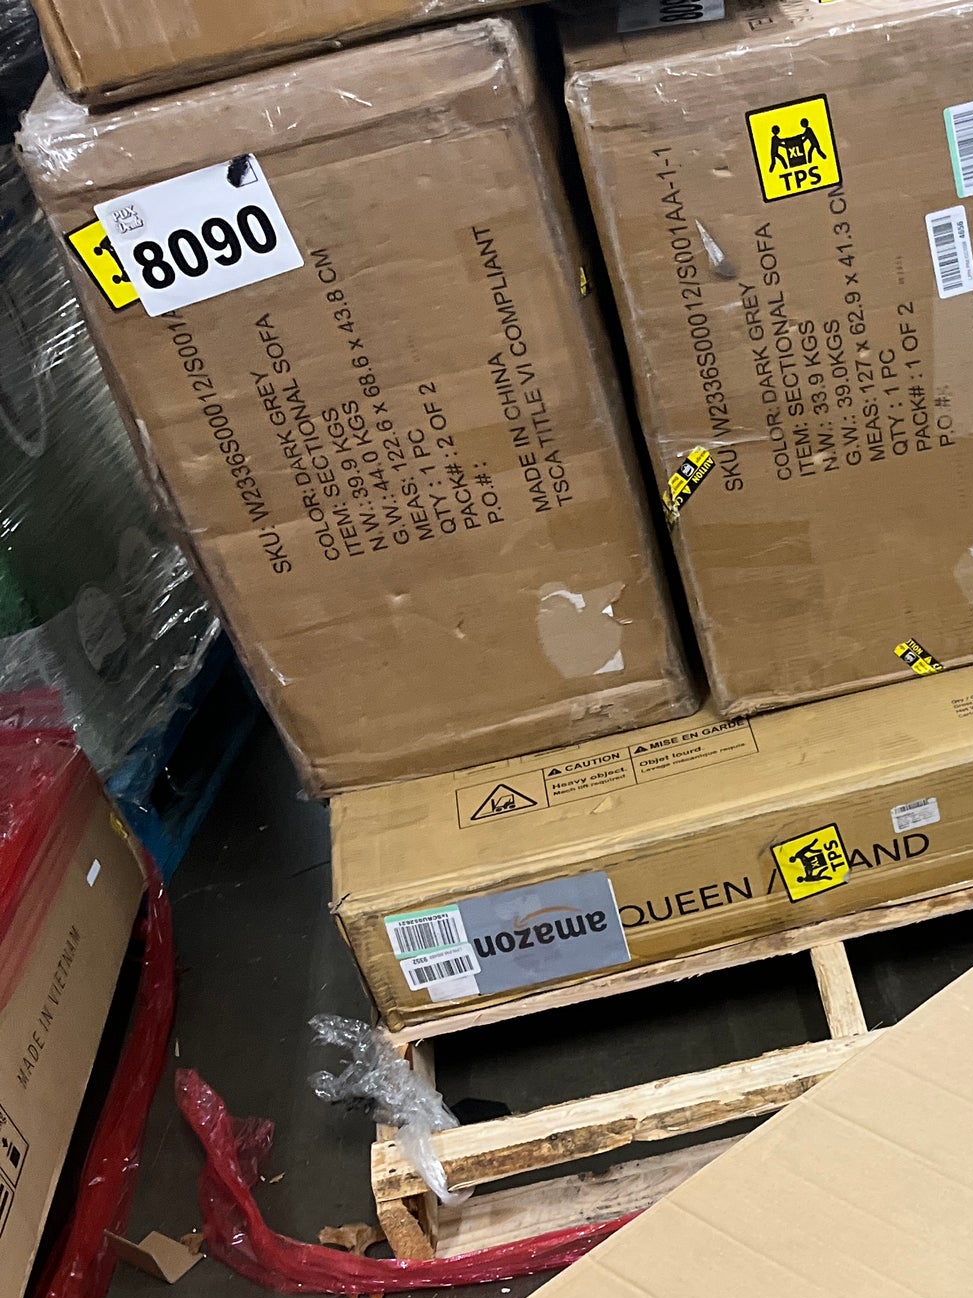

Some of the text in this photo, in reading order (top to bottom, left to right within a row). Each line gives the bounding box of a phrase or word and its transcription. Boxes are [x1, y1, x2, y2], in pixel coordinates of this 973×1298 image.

[788, 146, 804, 158] XL
[779, 166, 822, 191] TPS
[132, 204, 278, 289] 8090
[833, 221, 856, 267] 41.3
[956, 220, 965, 238] 4656
[310, 248, 337, 284] CM
[326, 289, 355, 333] 43.8
[738, 282, 764, 340] GREY
[844, 291, 866, 335] 62.9
[897, 301, 913, 315] 2
[754, 222, 815, 476] ITEM: SECTIONAL SOFA
[797, 319, 820, 366] KGS
[900, 322, 919, 352] OF
[351, 355, 381, 398] 68.6
[471, 226, 573, 505] TSCA TITLE VI COMPLIANT
[878, 348, 897, 378] PC
[250, 371, 287, 427] GREY
[418, 381, 436, 395] 2
[807, 373, 829, 415] 33.9
[255, 312, 364, 556] ITEM: SECTIONAL SOFA
[321, 407, 351, 454] KGS
[340, 399, 372, 446] KGS
[424, 402, 447, 431] OF
[487, 351, 552, 512] MADE IN CHINA
[375, 419, 408, 471] 122.6
[407, 428, 430, 458] PC
[401, 476, 435, 540] MEAS:
[258, 524, 293, 574] SKU:
[650, 718, 745, 750] MISE EN GARDE
[552, 777, 587, 790] Heavy
[565, 752, 621, 772] CAUTION
[826, 839, 845, 873] TPS
[618, 881, 752, 929] QUEEN
[847, 833, 931, 870] AND
[473, 911, 608, 957] amazon
[16, 924, 81, 1090] MADE IN VIETNAM
